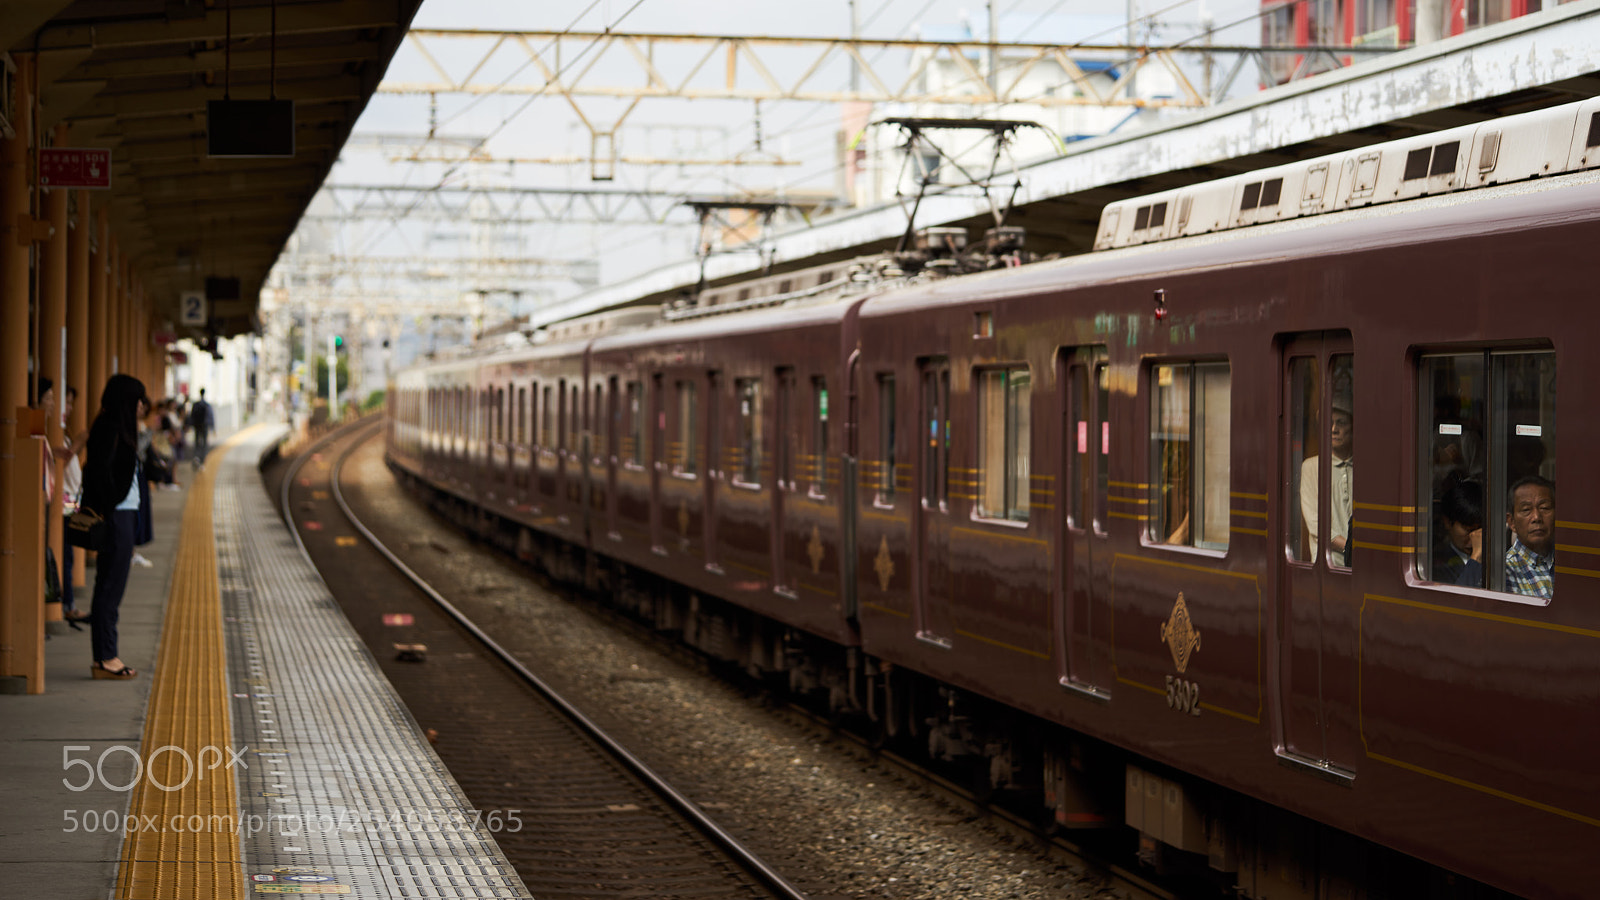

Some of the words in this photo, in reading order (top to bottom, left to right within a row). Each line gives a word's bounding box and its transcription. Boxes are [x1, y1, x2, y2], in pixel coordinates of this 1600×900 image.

[85, 153, 105, 163] SOS
[186, 296, 201, 320] 2
[1165, 675, 1201, 716] 5302
